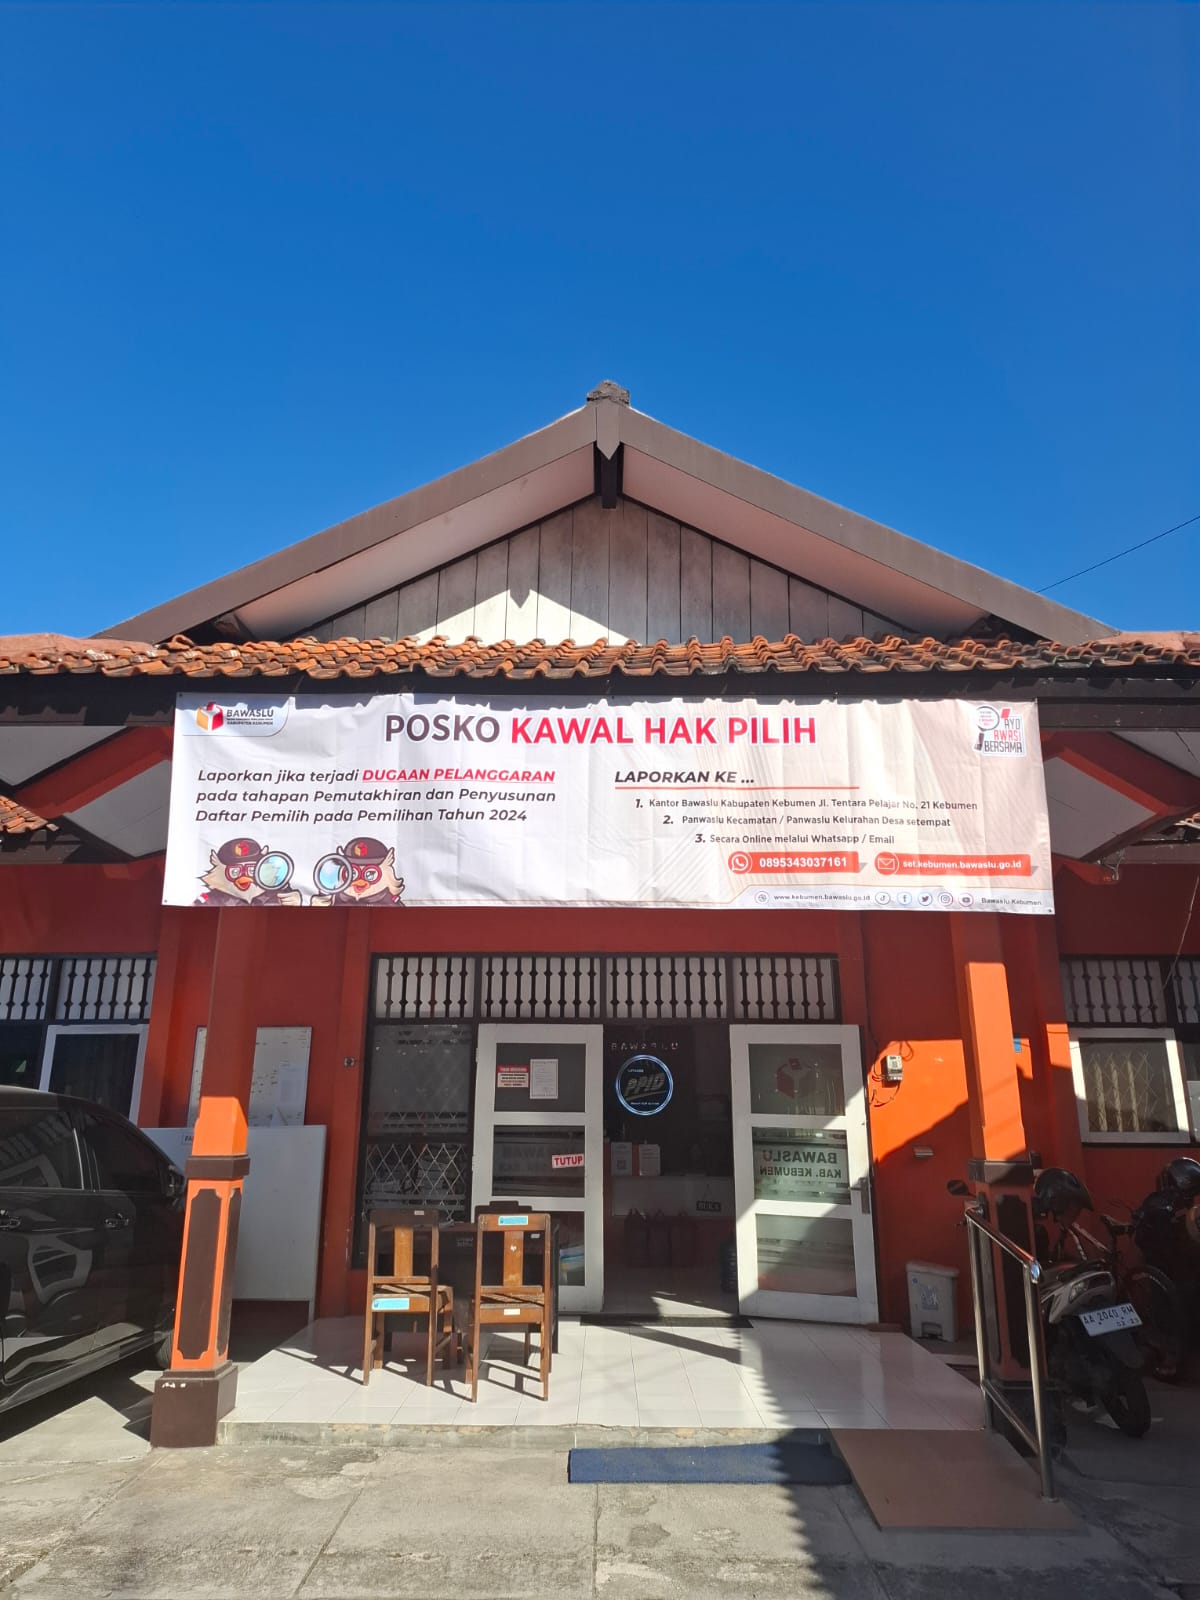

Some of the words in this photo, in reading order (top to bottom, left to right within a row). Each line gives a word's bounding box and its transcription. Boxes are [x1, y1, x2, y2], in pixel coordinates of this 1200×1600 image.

[226, 709, 274, 718] BAWASLU
[385, 714, 500, 743] POSKO
[511, 717, 634, 744] KAWAL
[645, 717, 717, 744] HAK
[728, 716, 816, 744] PILIH
[1004, 718, 1020, 730] AYO
[993, 729, 1021, 742] AWASI
[984, 740, 1023, 753] BERSAMA
[198, 769, 272, 784] Laporkan
[275, 769, 305, 784] jika
[310, 769, 359, 784] terjadi
[362, 768, 430, 781] DUGAAN
[433, 768, 556, 782] PELANGGARAN
[614, 771, 710, 783] LAPORKAN
[714, 771, 738, 783] KE
[196, 789, 237, 804] pada
[242, 790, 309, 804] tahapan
[313, 788, 421, 802] Pemutakhiran
[425, 788, 454, 800] dan
[458, 788, 556, 803] Penyusunan
[635, 798, 643, 809] 1.
[649, 799, 679, 808] Kantor
[682, 799, 719, 808] Bawaslu
[721, 799, 770, 809] Kabupaten
[772, 799, 816, 808] Kebumen
[818, 799, 829, 808] Jl.
[832, 799, 866, 808] Tentara
[869, 799, 900, 810] Pelajar
[902, 801, 918, 809] No.
[920, 801, 930, 810] 21
[932, 801, 978, 811] Kebumen
[195, 809, 247, 822] Daftar
[251, 809, 309, 822] Pemilih
[313, 810, 353, 824] pada
[357, 809, 433, 822] Pemilihan
[438, 808, 485, 821] Tahun
[489, 809, 527, 821] 2024
[662, 815, 674, 825] 2.
[682, 815, 724, 824] Panwaslu
[726, 816, 777, 825] Kecamatan
[786, 815, 830, 824] Panwaslu
[832, 816, 879, 825] Kelurahan
[882, 816, 904, 825] Desa
[906, 818, 951, 828] setempat
[695, 833, 706, 843] 3.
[710, 835, 740, 843] Secara
[742, 835, 772, 843] Online
[774, 835, 809, 843] melalui
[811, 835, 860, 845] Whatsapp
[868, 835, 894, 844] Email
[759, 857, 847, 868] 0895343037161
[903, 859, 1022, 870] set.kebumen.bawaslu.go.id
[773, 893, 871, 902] www.kebumen.bawaslu.go.id
[981, 897, 1010, 905] Bawaslu
[1011, 898, 1042, 906] Kebumen
[554, 1156, 583, 1165] TUTUP
